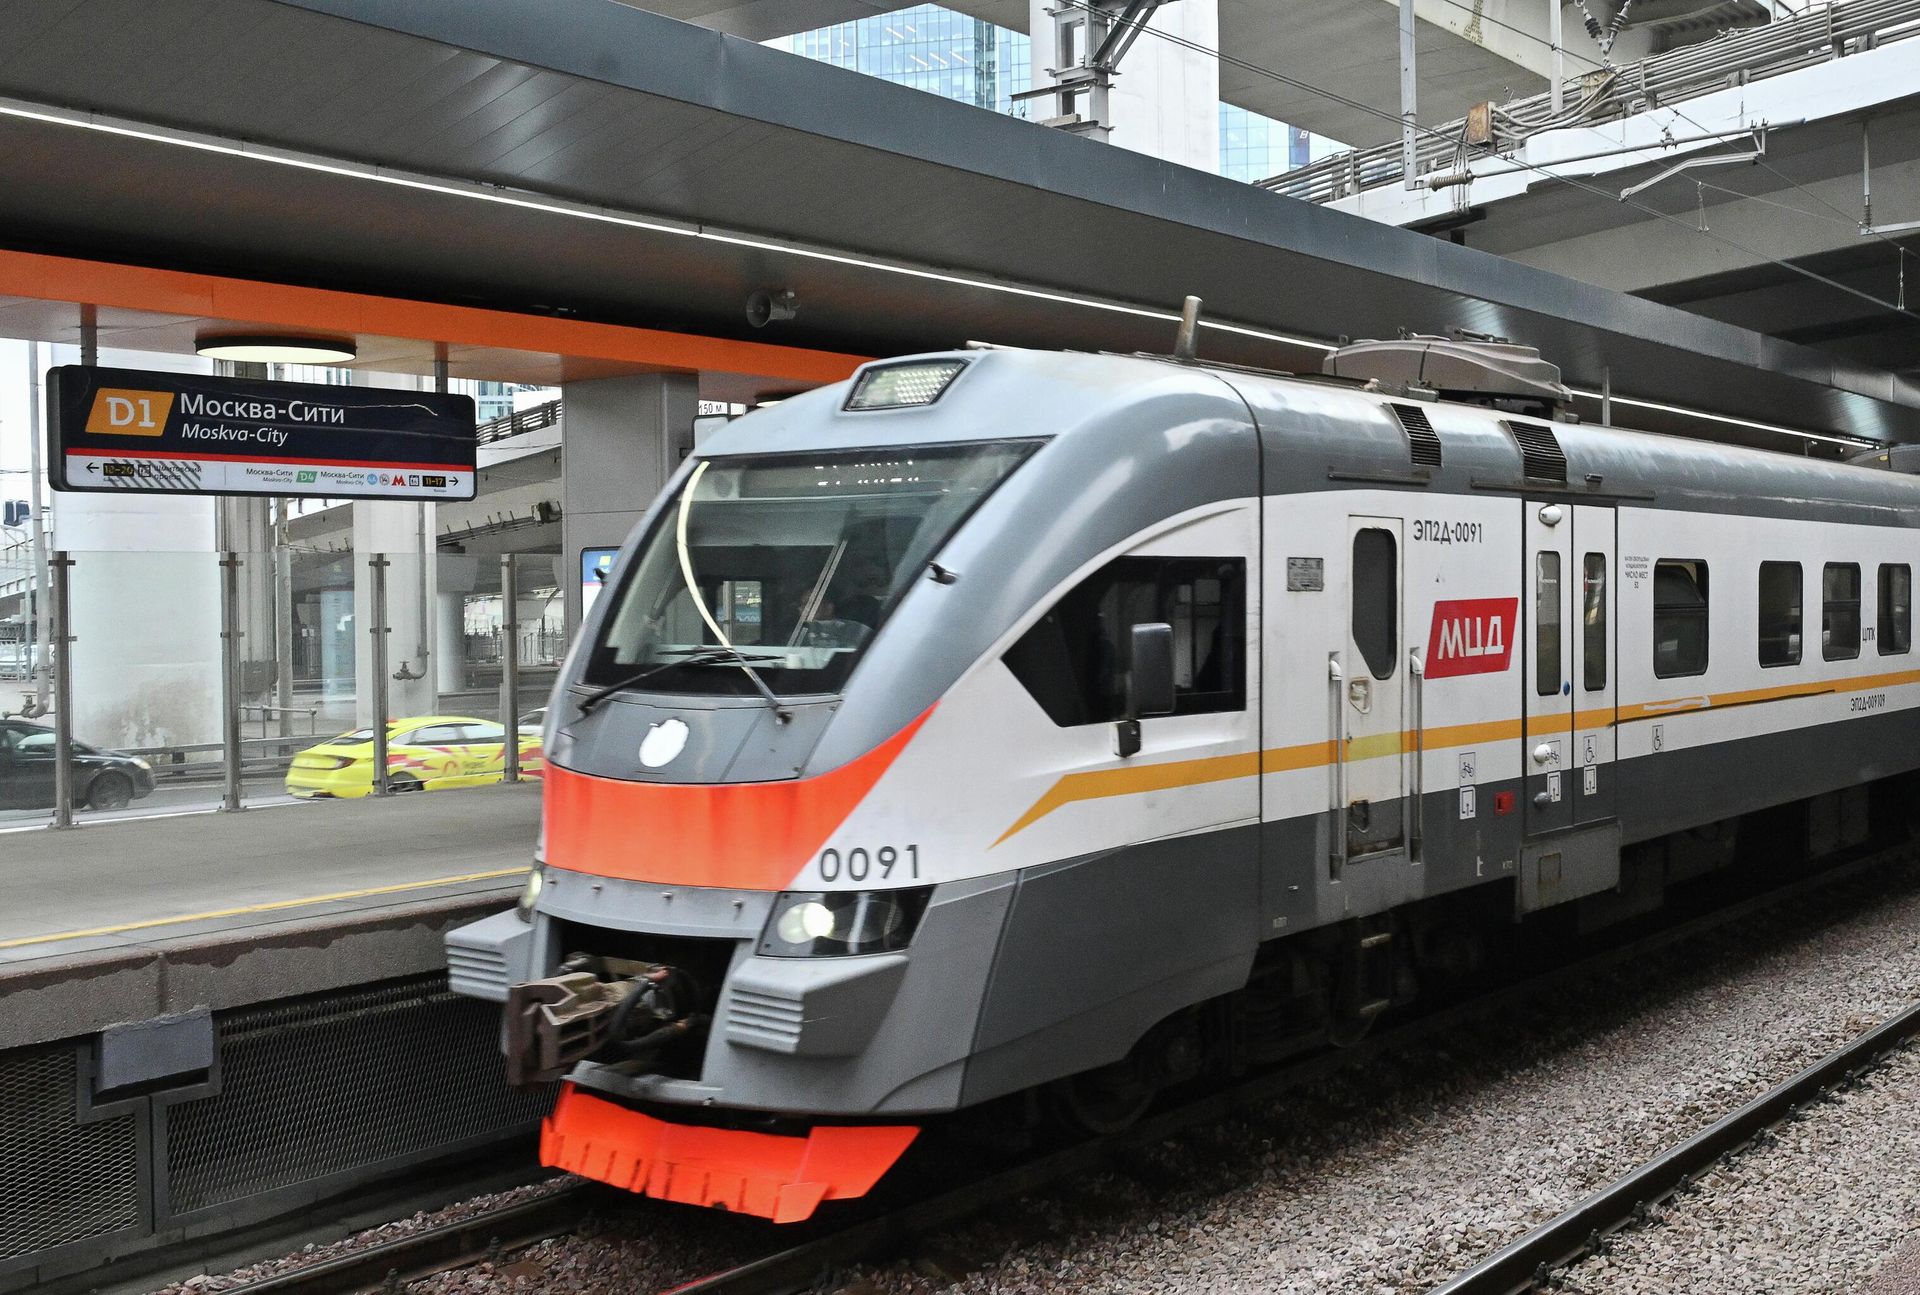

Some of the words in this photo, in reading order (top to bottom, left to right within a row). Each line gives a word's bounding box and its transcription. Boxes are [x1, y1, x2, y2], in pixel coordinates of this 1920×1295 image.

[105, 396, 156, 428] D1
[180, 392, 345, 424] Москва-Сити
[181, 423, 289, 447] Moskva-City
[246, 468, 293, 477] Москва-Сити
[300, 472, 316, 481] D4
[320, 471, 365, 480] Москва-Сити
[1413, 519, 1483, 545] ЭП2Д-0091
[1437, 616, 1505, 660] МЦД
[820, 844, 919, 882] 0091
